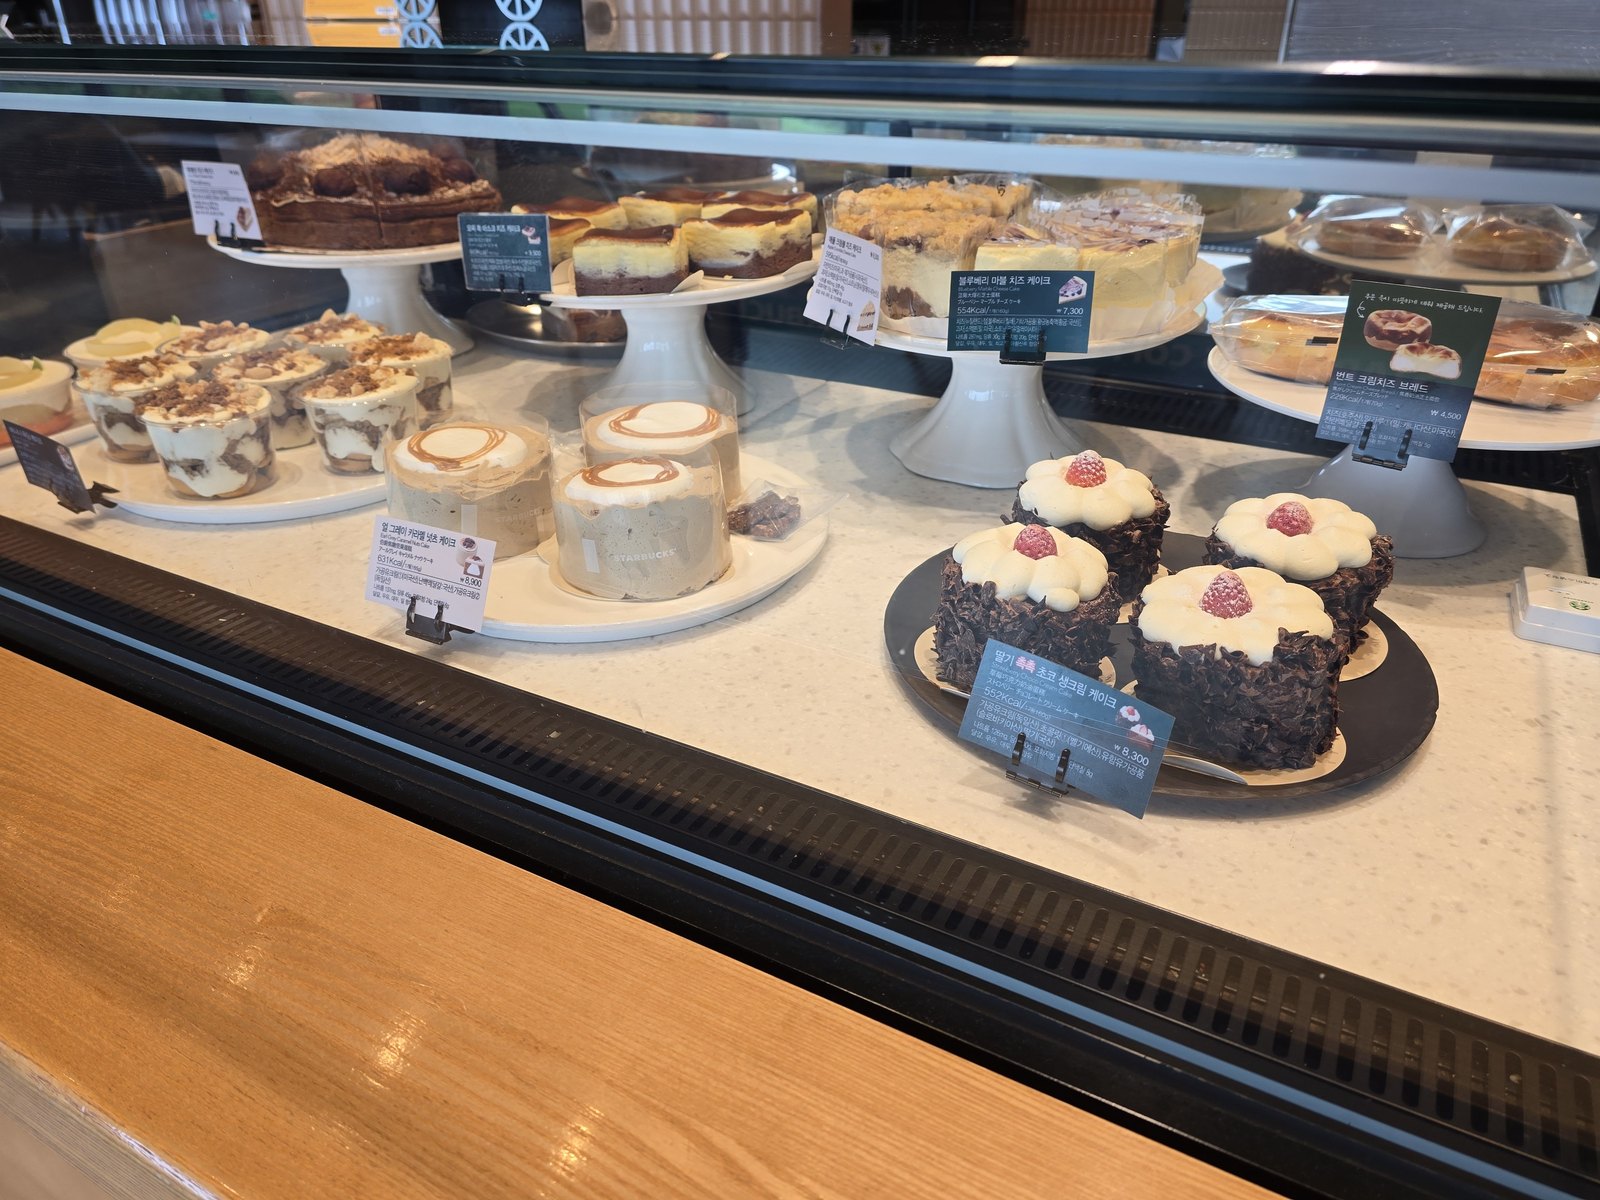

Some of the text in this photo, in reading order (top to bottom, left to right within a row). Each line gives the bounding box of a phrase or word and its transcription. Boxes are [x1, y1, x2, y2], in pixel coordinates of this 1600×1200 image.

[959, 276, 1051, 286] 블루베리 마블 치즈 케이크
[1063, 307, 1084, 315] 7,300
[1336, 371, 1428, 393] 번트 크림치즈 브레드
[1440, 411, 1461, 420] 4,500
[381, 522, 388, 532] 얼
[389, 524, 407, 536] 그레이
[439, 536, 456, 547] 케이크
[614, 548, 677, 562] STARBUCKS
[995, 650, 1116, 708] 딸기 촉촉 초코 생크림 케이크
[1122, 747, 1149, 766] 8,300
